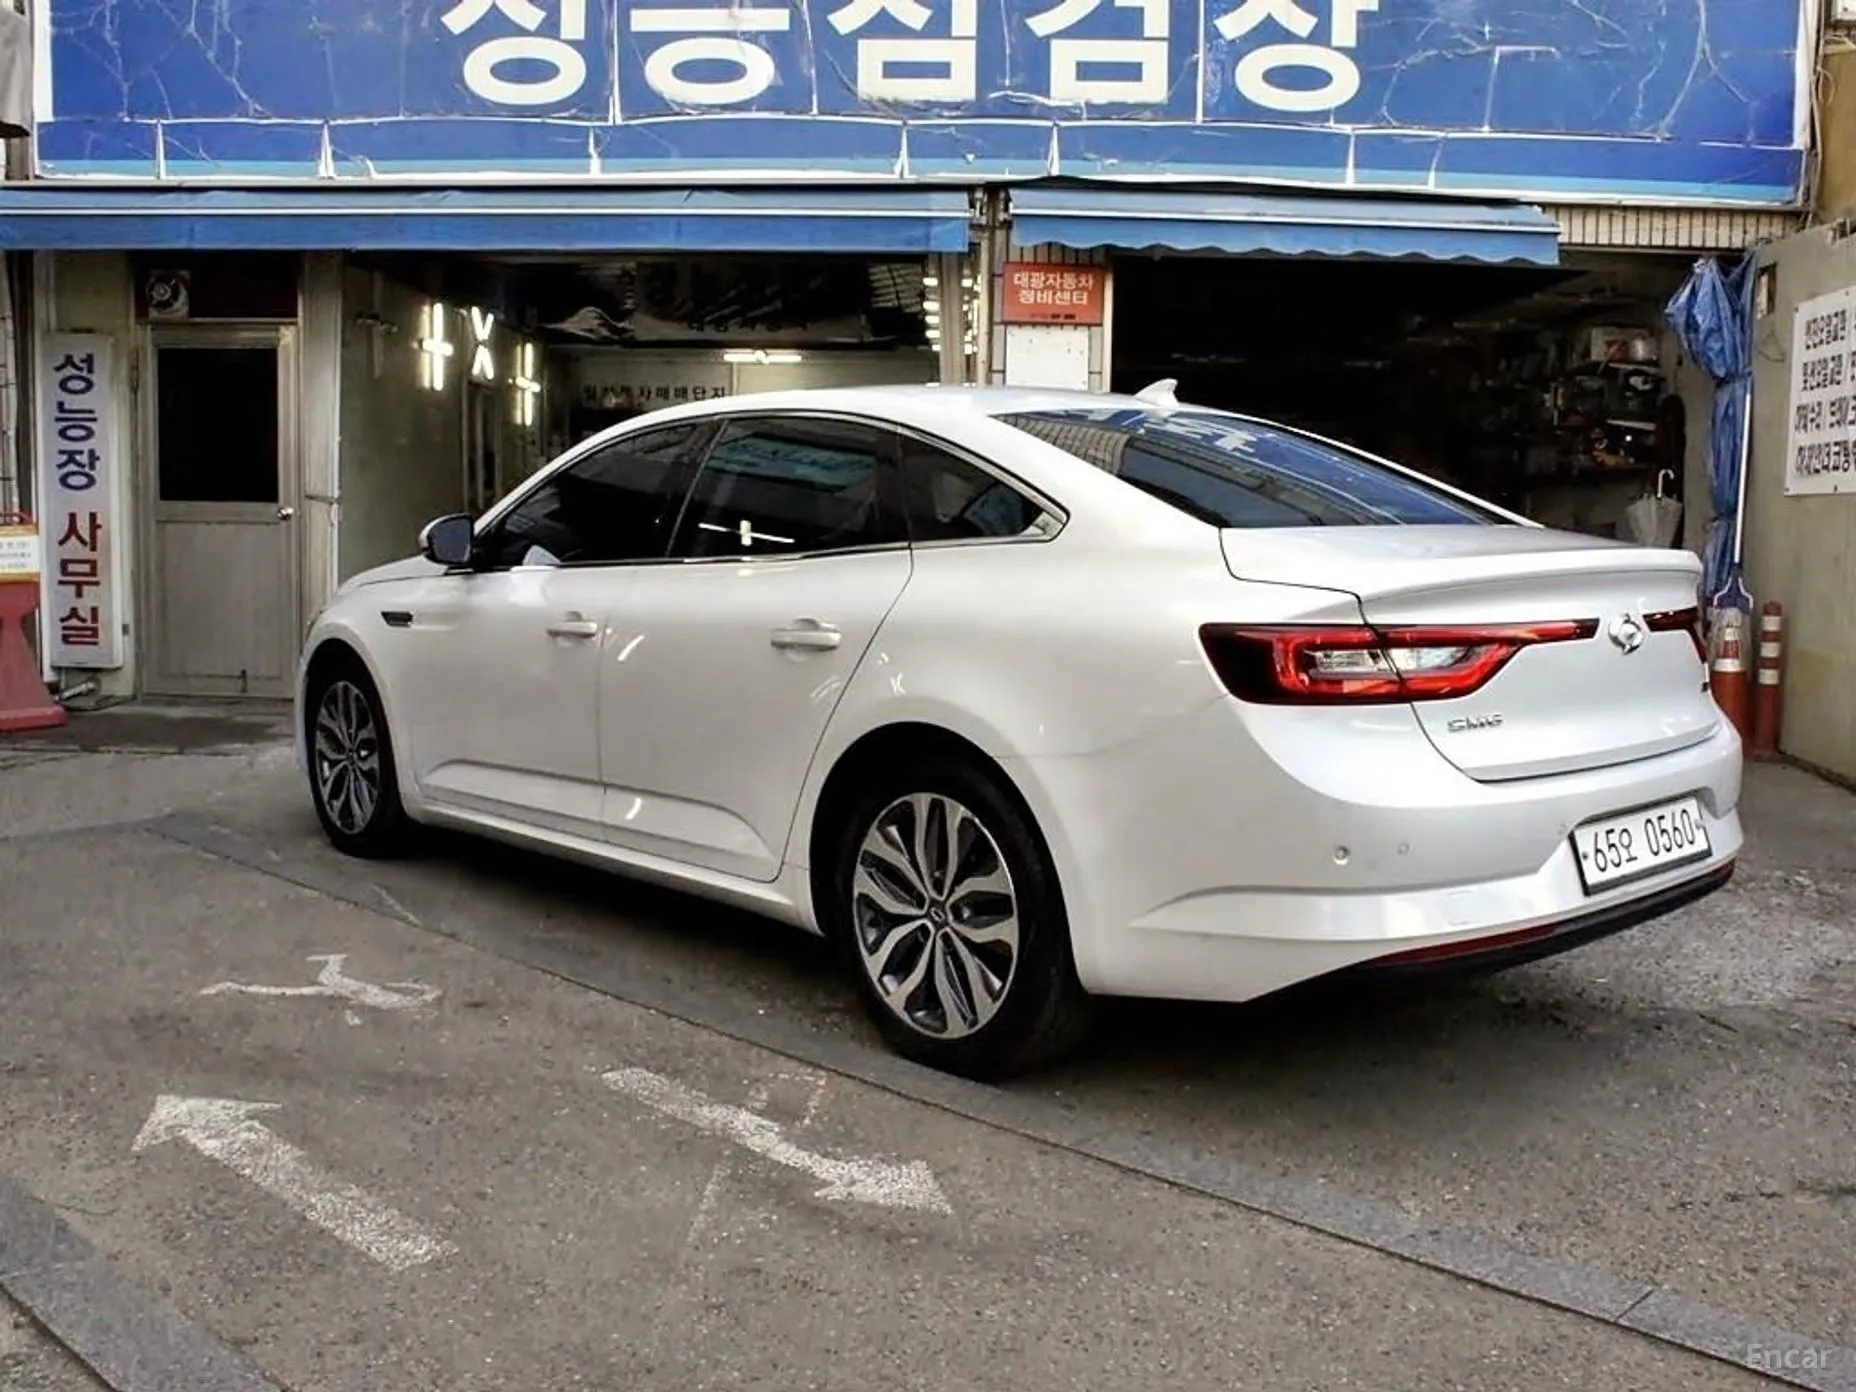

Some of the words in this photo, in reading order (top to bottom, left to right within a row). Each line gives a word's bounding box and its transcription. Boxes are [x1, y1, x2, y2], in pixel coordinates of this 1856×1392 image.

[54, 352, 100, 492] 성능장
[57, 511, 103, 647] 사무실
[1593, 827, 1638, 872] 65오
[1643, 808, 1696, 857] 0560
